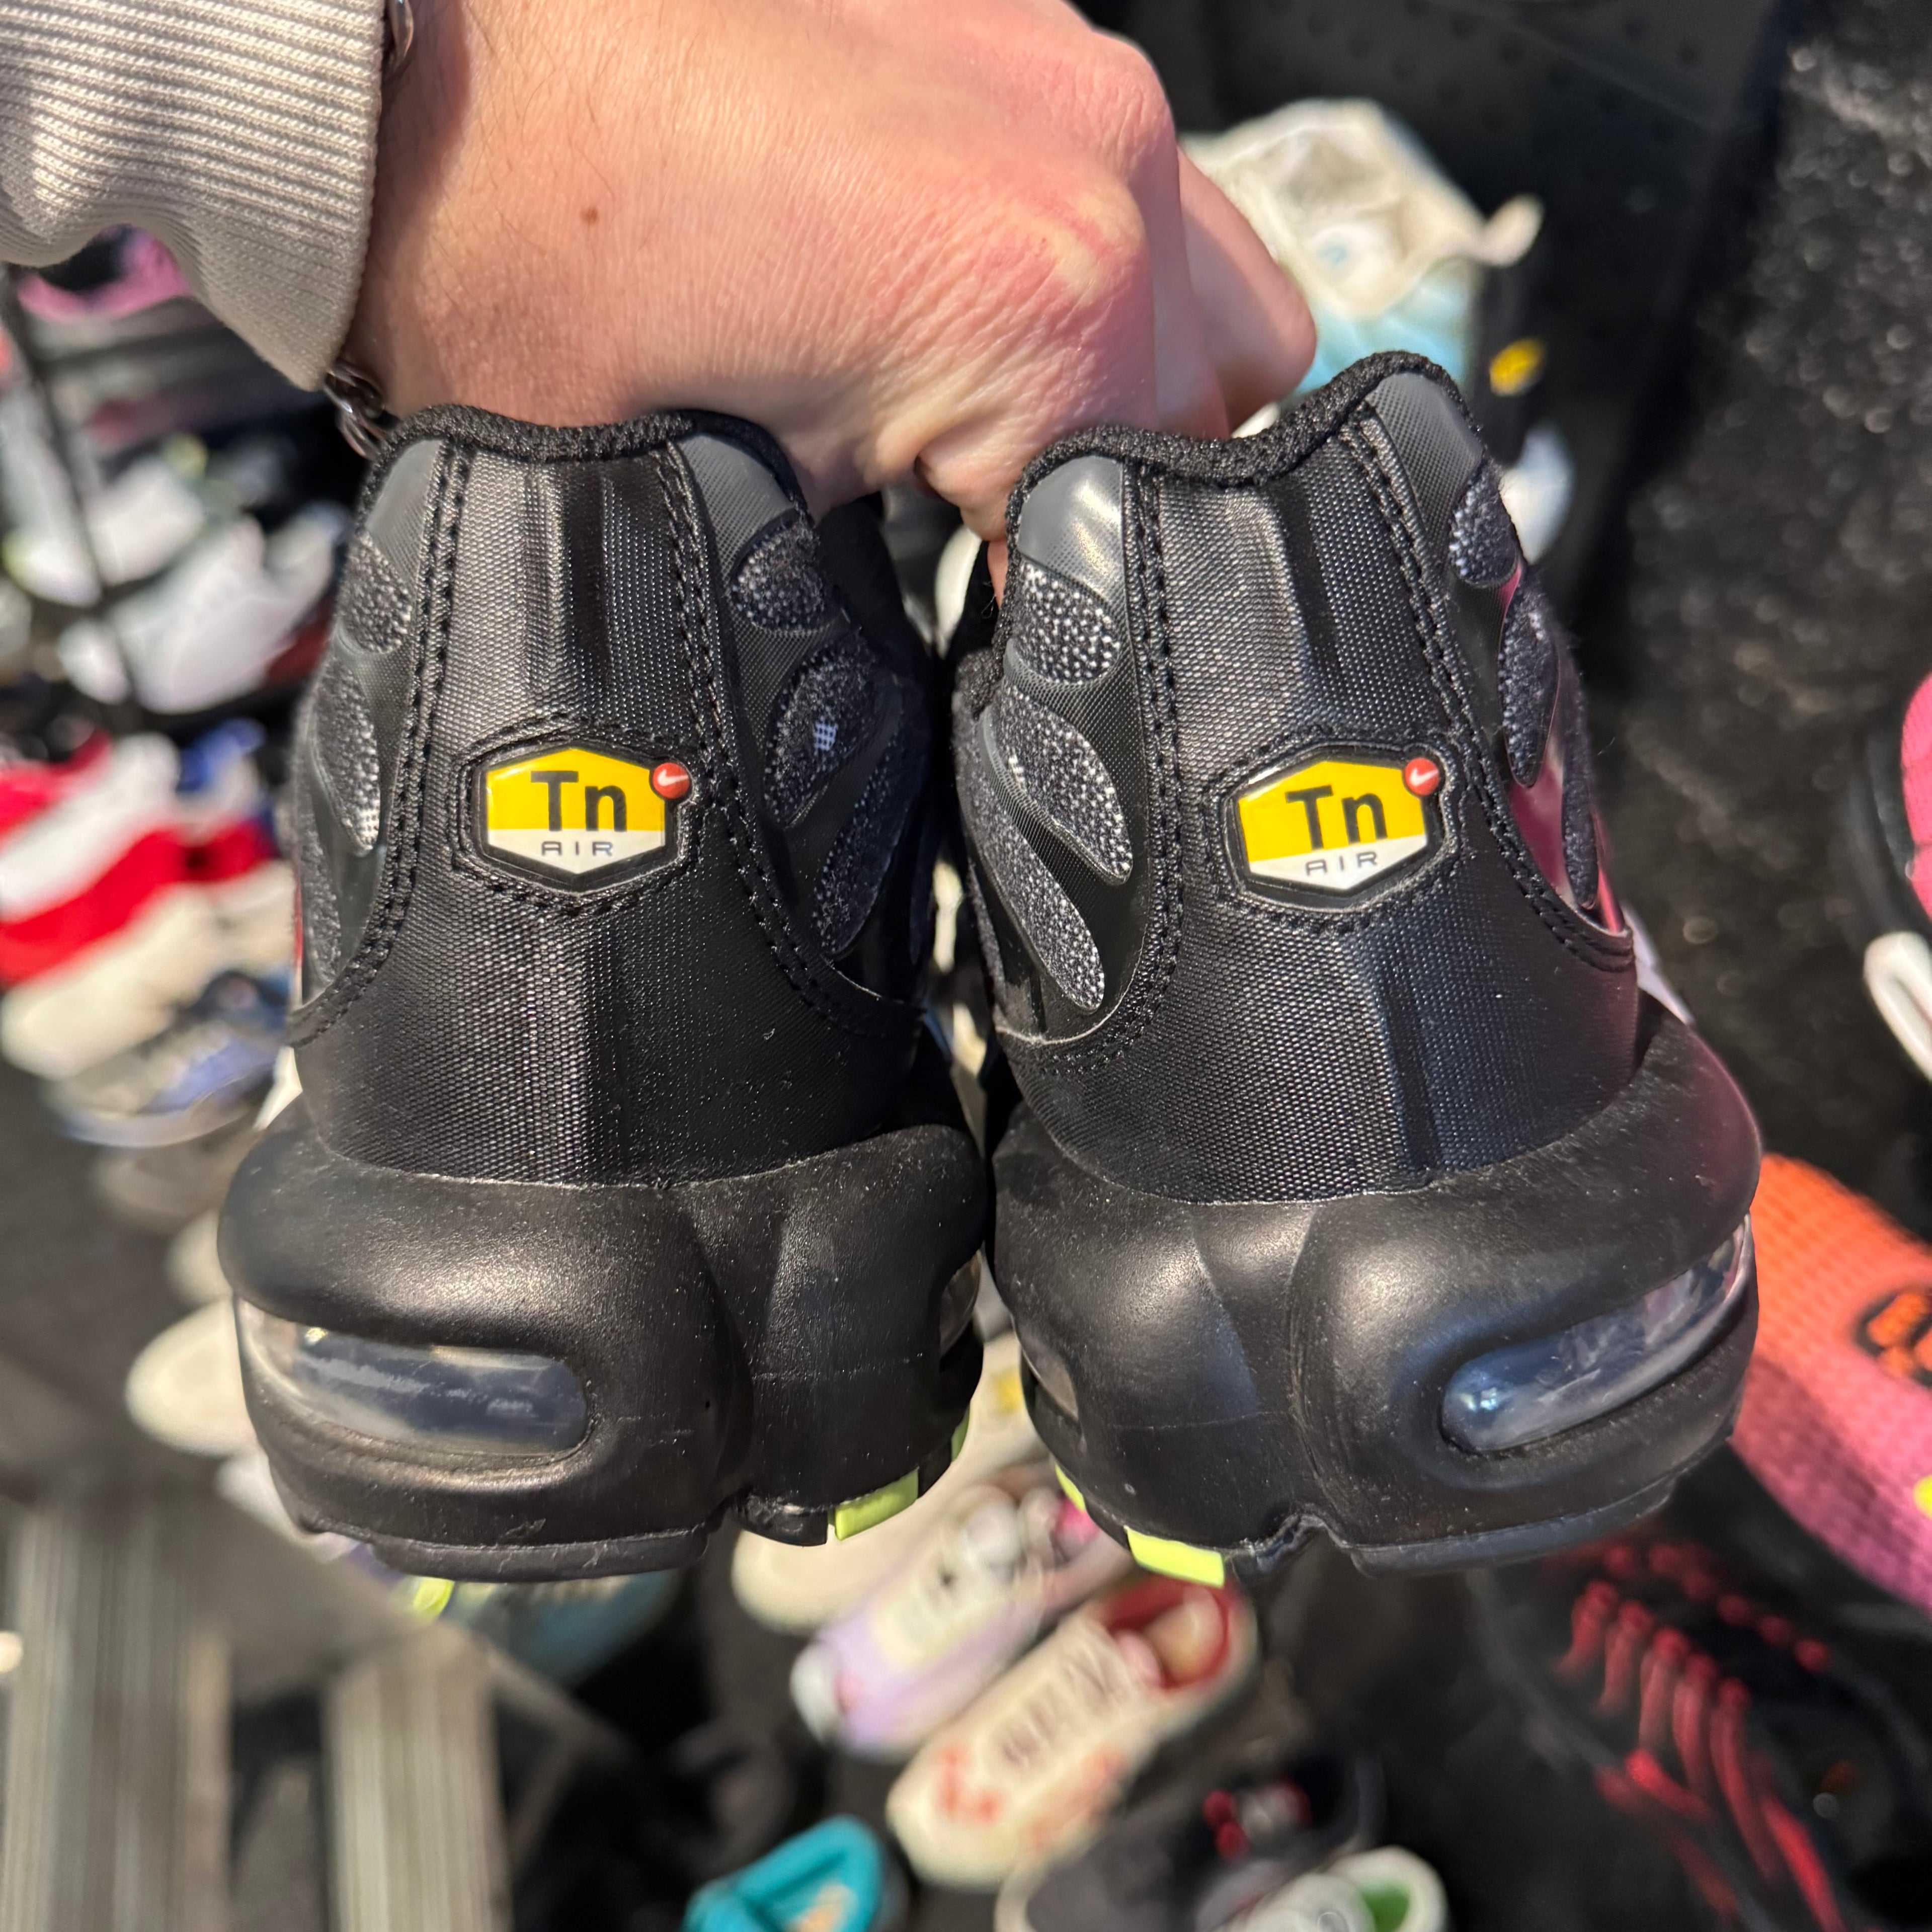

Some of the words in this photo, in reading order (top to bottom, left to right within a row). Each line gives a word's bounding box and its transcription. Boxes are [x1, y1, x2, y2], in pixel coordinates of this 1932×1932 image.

[530, 770, 627, 832] Tn
[1285, 785, 1388, 851] Tn
[541, 841, 613, 856] AIR
[1305, 851, 1378, 876] AIR
